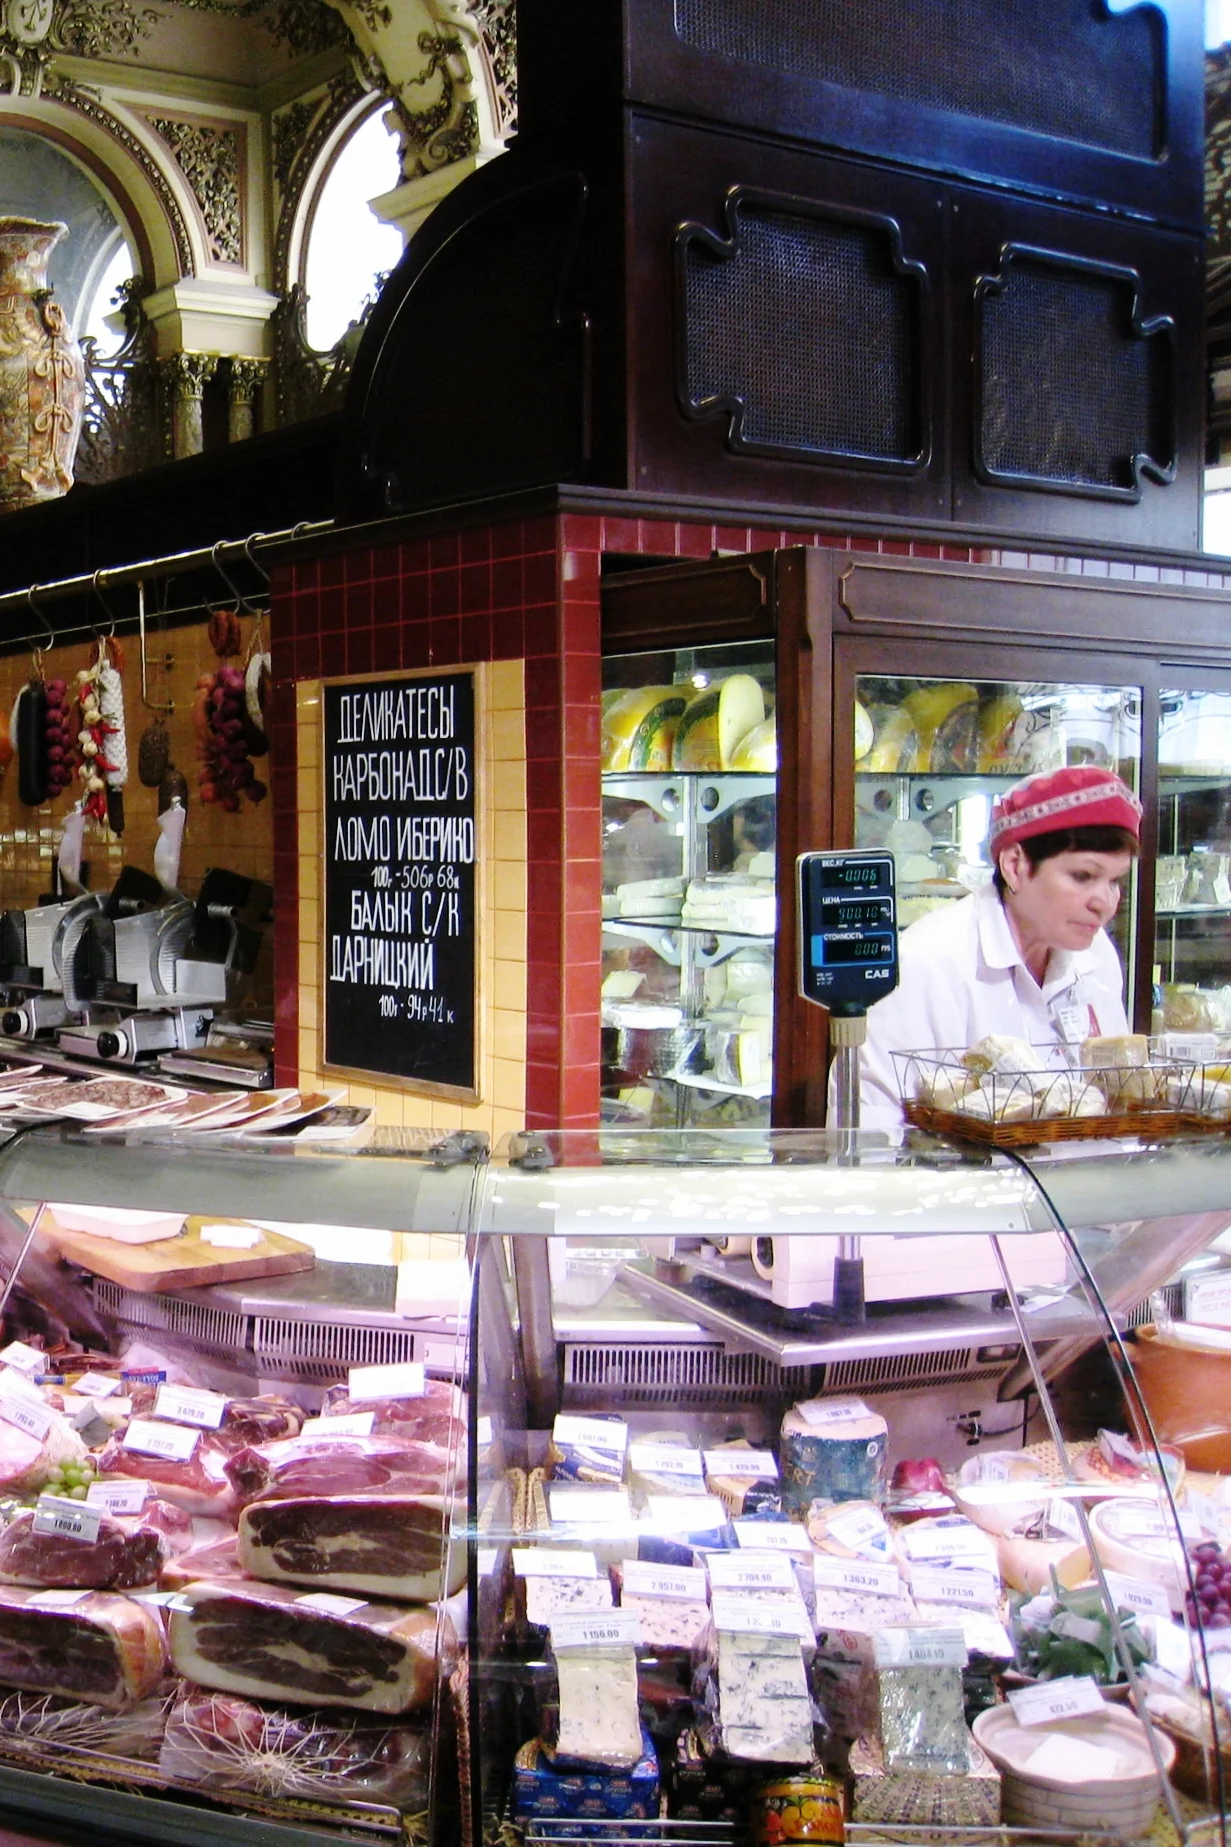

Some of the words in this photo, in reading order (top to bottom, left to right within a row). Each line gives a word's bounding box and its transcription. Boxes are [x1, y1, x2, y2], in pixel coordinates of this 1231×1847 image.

[337, 686, 454, 743] ДЕЛИКАТЕСЫ
[333, 749, 434, 802] КАРБОНАД
[334, 815, 390, 861] ЛОМО
[397, 816, 475, 864] ИБЕРИКО
[350, 890, 412, 935] БАЛЫК
[421, 891, 460, 937] С/К
[822, 896, 841, 905] ЦЕНА
[823, 931, 864, 941] СТОИМОСТЬ
[329, 933, 434, 991] ДАРНИЦКИЙ
[865, 968, 890, 980] CAS
